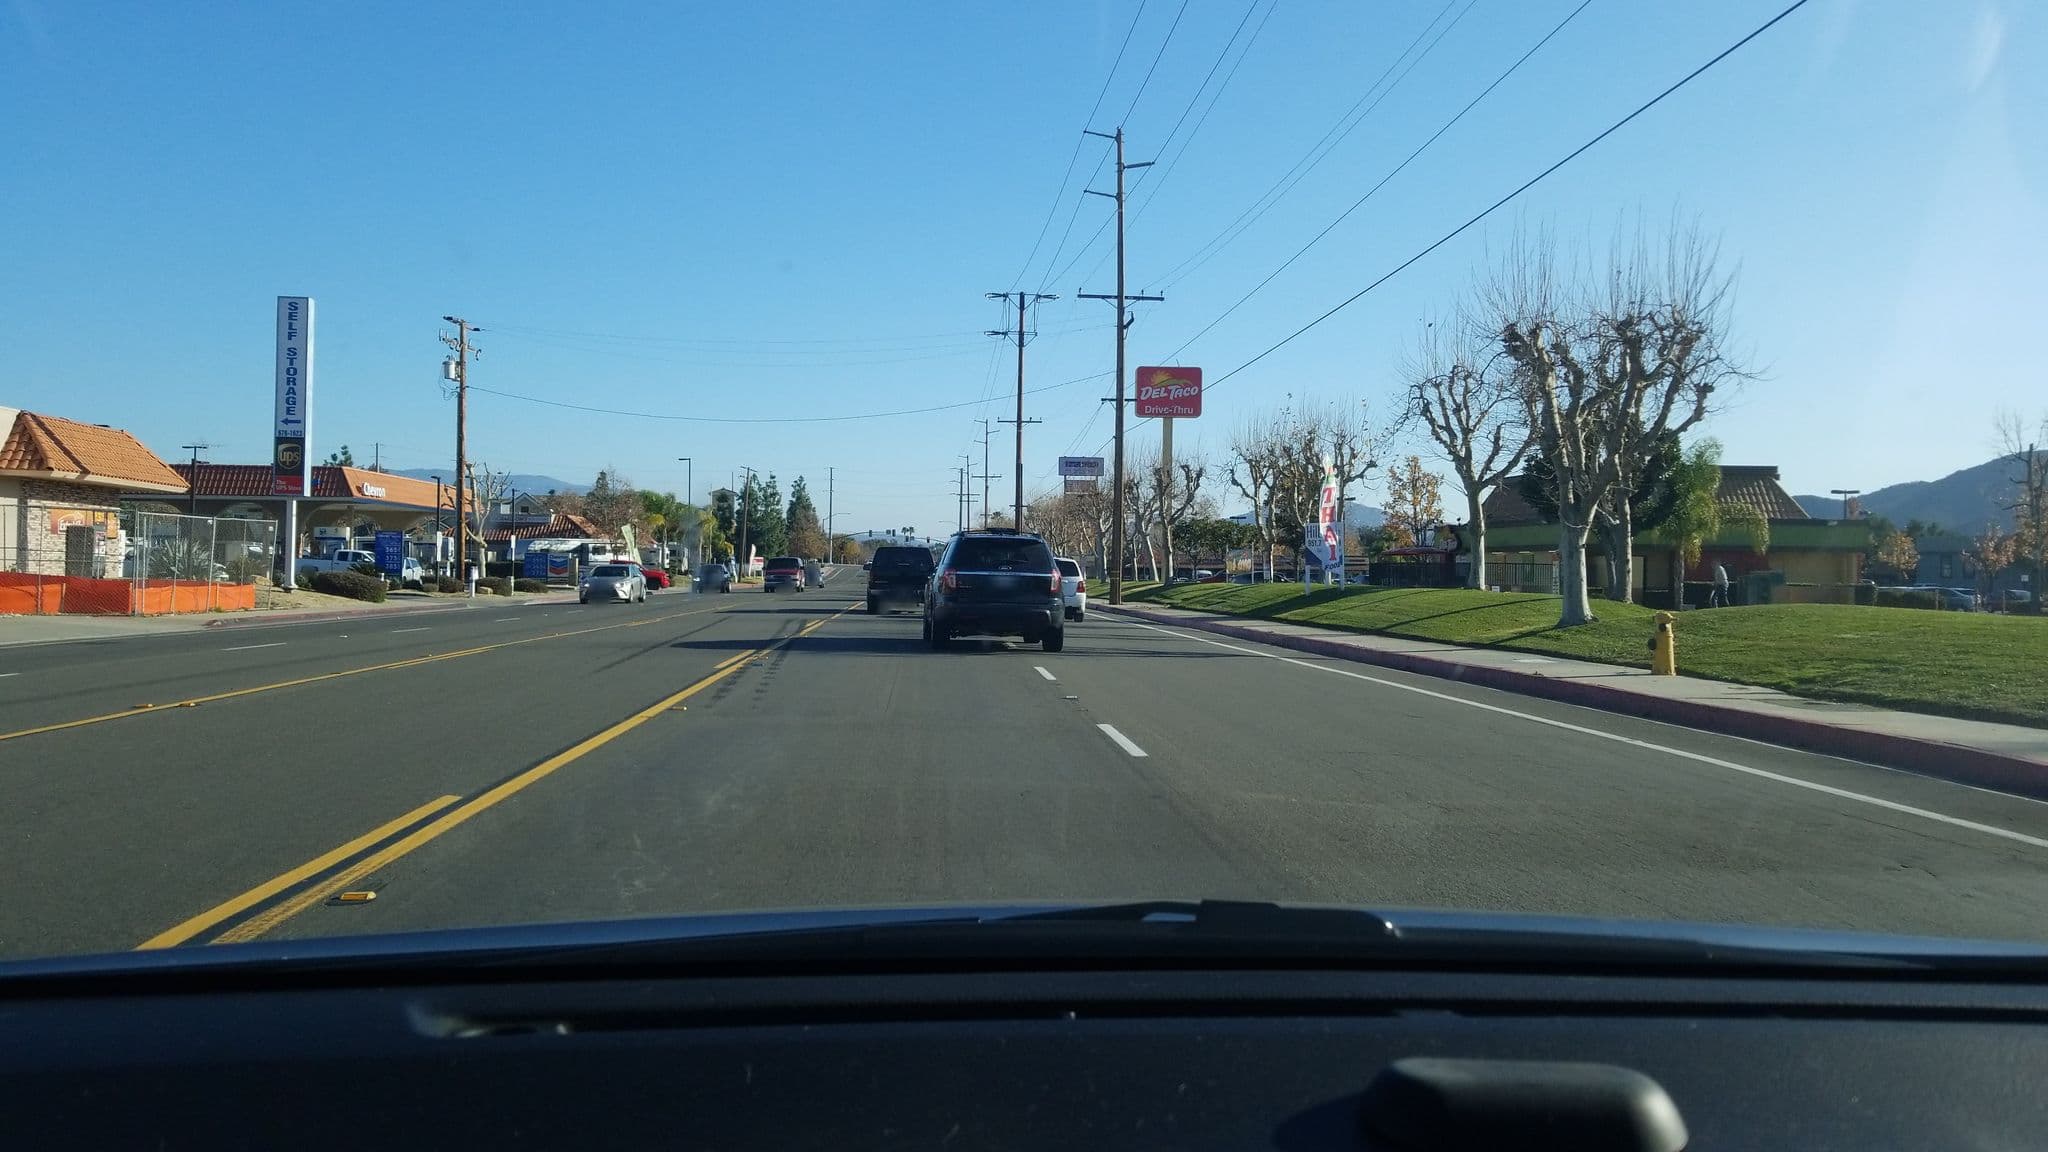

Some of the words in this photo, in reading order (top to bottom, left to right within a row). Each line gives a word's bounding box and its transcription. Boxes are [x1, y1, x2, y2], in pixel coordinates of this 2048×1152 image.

[287, 301, 299, 341] SELF
[285, 347, 298, 416] STORAGE
[1140, 386, 1168, 401] DEL
[1144, 405, 1194, 415] Drive-Thru
[279, 451, 299, 466] ups
[1320, 487, 1338, 561] THAI
